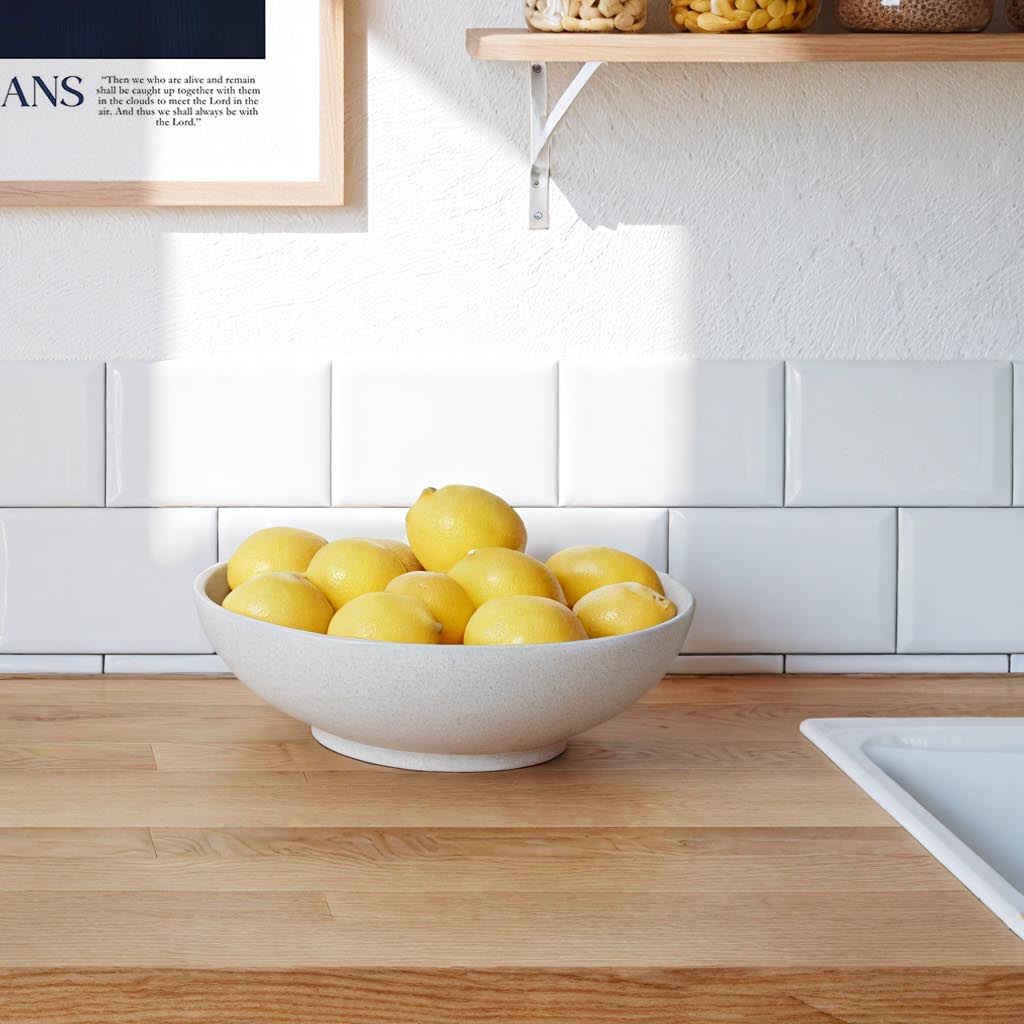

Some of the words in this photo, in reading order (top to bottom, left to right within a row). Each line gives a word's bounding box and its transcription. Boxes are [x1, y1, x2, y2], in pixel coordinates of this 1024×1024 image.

[132, 77, 144, 85] we
[147, 75, 166, 84] who
[184, 76, 204, 85] alive
[207, 75, 223, 84] and
[226, 76, 255, 85] remain
[96, 86, 116, 95] shall
[119, 86, 129, 95] be
[132, 86, 161, 96] caught
[164, 89, 175, 97] up
[178, 86, 214, 96] together
[216, 86, 235, 95] with
[238, 86, 260, 95] them
[98, 97, 107, 105] in
[109, 97, 123, 106] the
[126, 96, 154, 105] clouds
[157, 98, 166, 106] to
[169, 98, 190, 106] meet
[193, 97, 207, 106] the
[210, 97, 231, 106] Lord
[233, 97, 242, 105] in
[245, 97, 259, 106] the
[98, 107, 112, 116] air.
[115, 107, 134, 116] And
[136, 107, 155, 116] thus
[173, 107, 193, 116] shall
[195, 107, 223, 118] always
[226, 107, 236, 116] be
[239, 107, 258, 116] with
[156, 118, 170, 127] the
